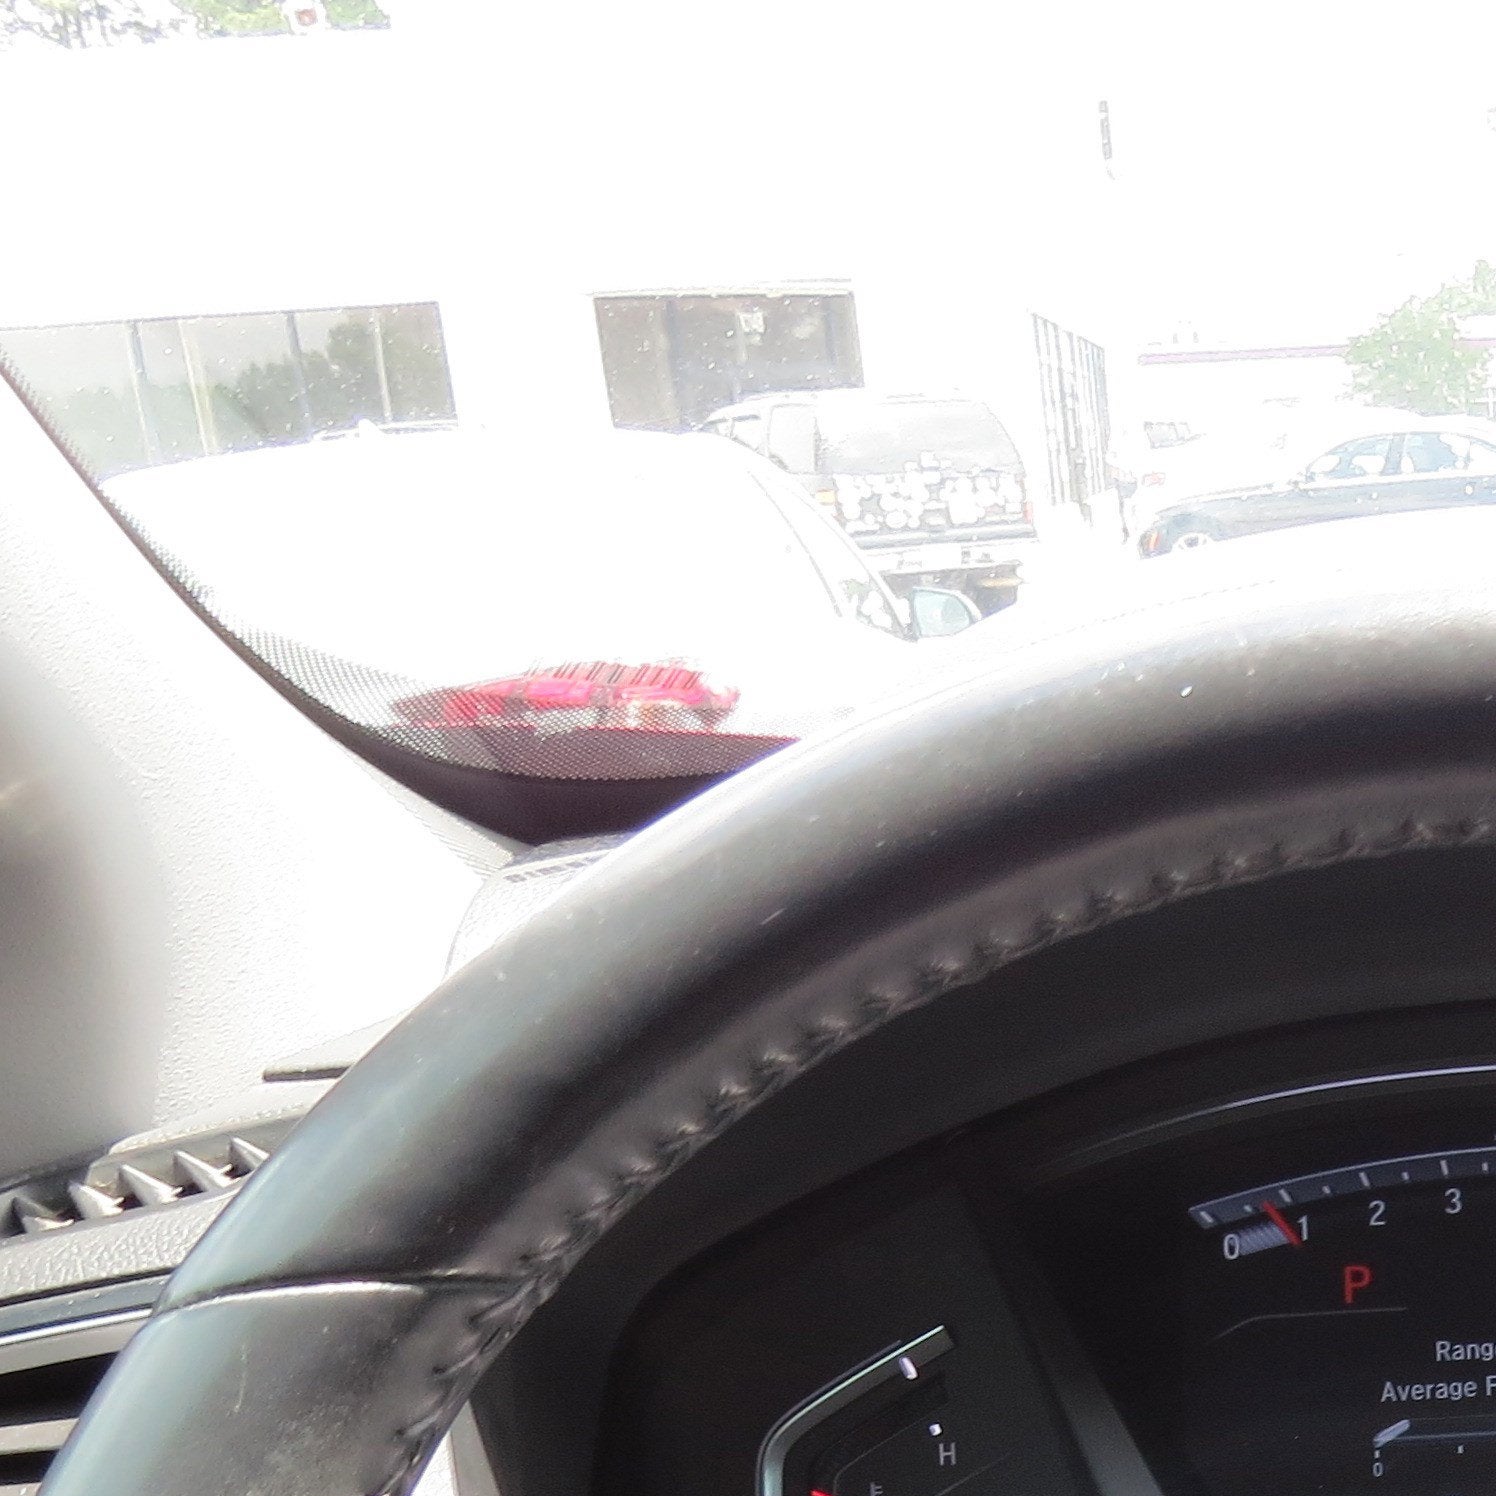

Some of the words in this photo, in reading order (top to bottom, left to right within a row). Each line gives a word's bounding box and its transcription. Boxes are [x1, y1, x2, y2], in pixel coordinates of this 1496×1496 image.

[1368, 1200, 1387, 1226] 2
[1444, 1188, 1462, 1214] 3
[1297, 1215, 1309, 1242] 1
[1223, 1233, 1240, 1260] 0
[1343, 1264, 1373, 1304] P
[1381, 1380, 1478, 1402] Average
[938, 1442, 957, 1466] H
[1372, 1462, 1384, 1477] 0
